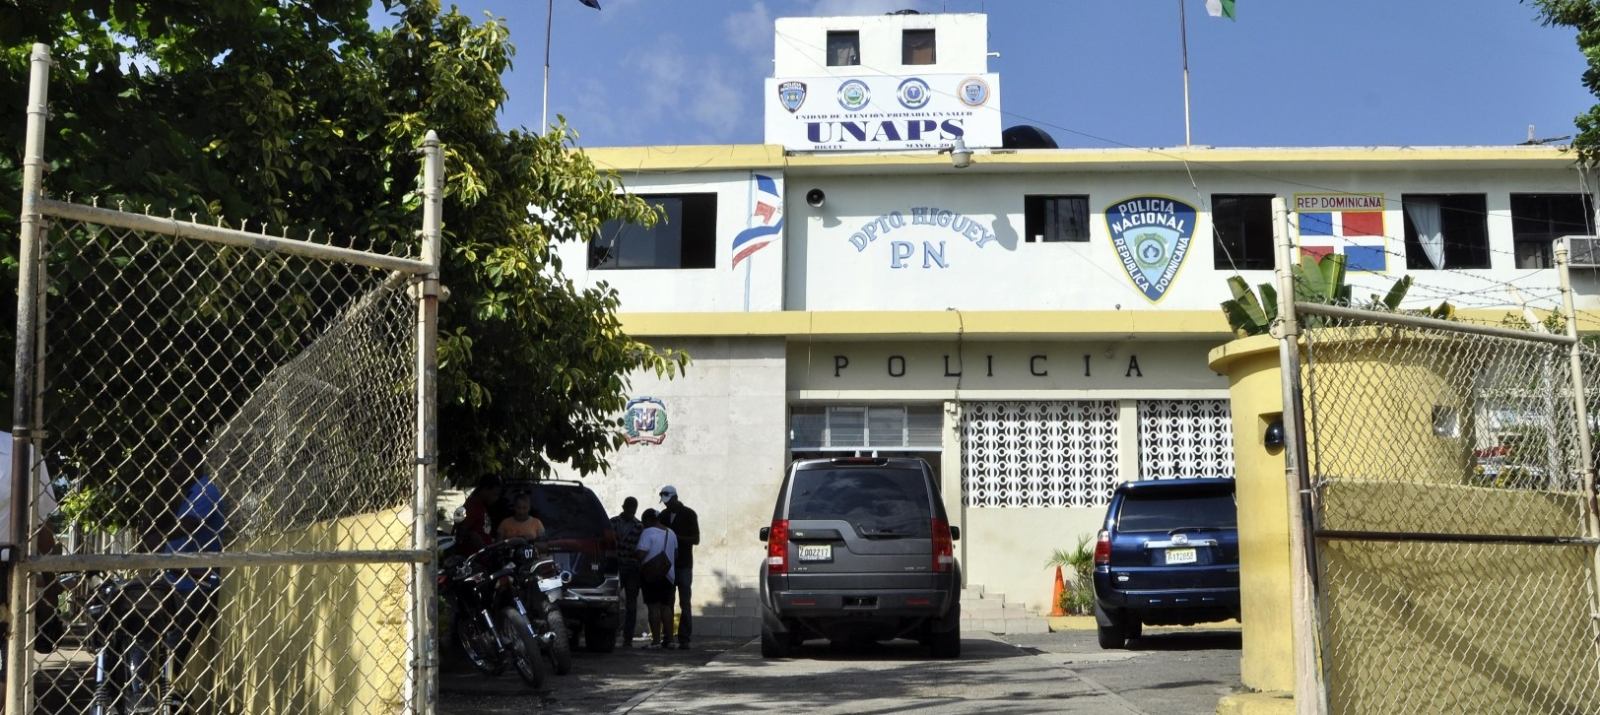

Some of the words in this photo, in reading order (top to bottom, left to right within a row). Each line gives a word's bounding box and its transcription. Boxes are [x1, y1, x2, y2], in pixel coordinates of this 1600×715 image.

[804, 118, 964, 143] UNAPS
[1118, 199, 1174, 217] POLICIA
[1297, 197, 1318, 208] REP
[1321, 197, 1382, 208] DOMINICANA
[911, 207, 998, 249] HIGUEY
[1111, 212, 1185, 234] NACIONAL
[890, 240, 915, 269] P.
[922, 240, 950, 269] N.
[1114, 237, 1150, 293] REPUBLICA
[1155, 237, 1190, 293] DOMINICANA
[833, 355, 1143, 377] POLICIA
[524, 549, 533, 559] 07
